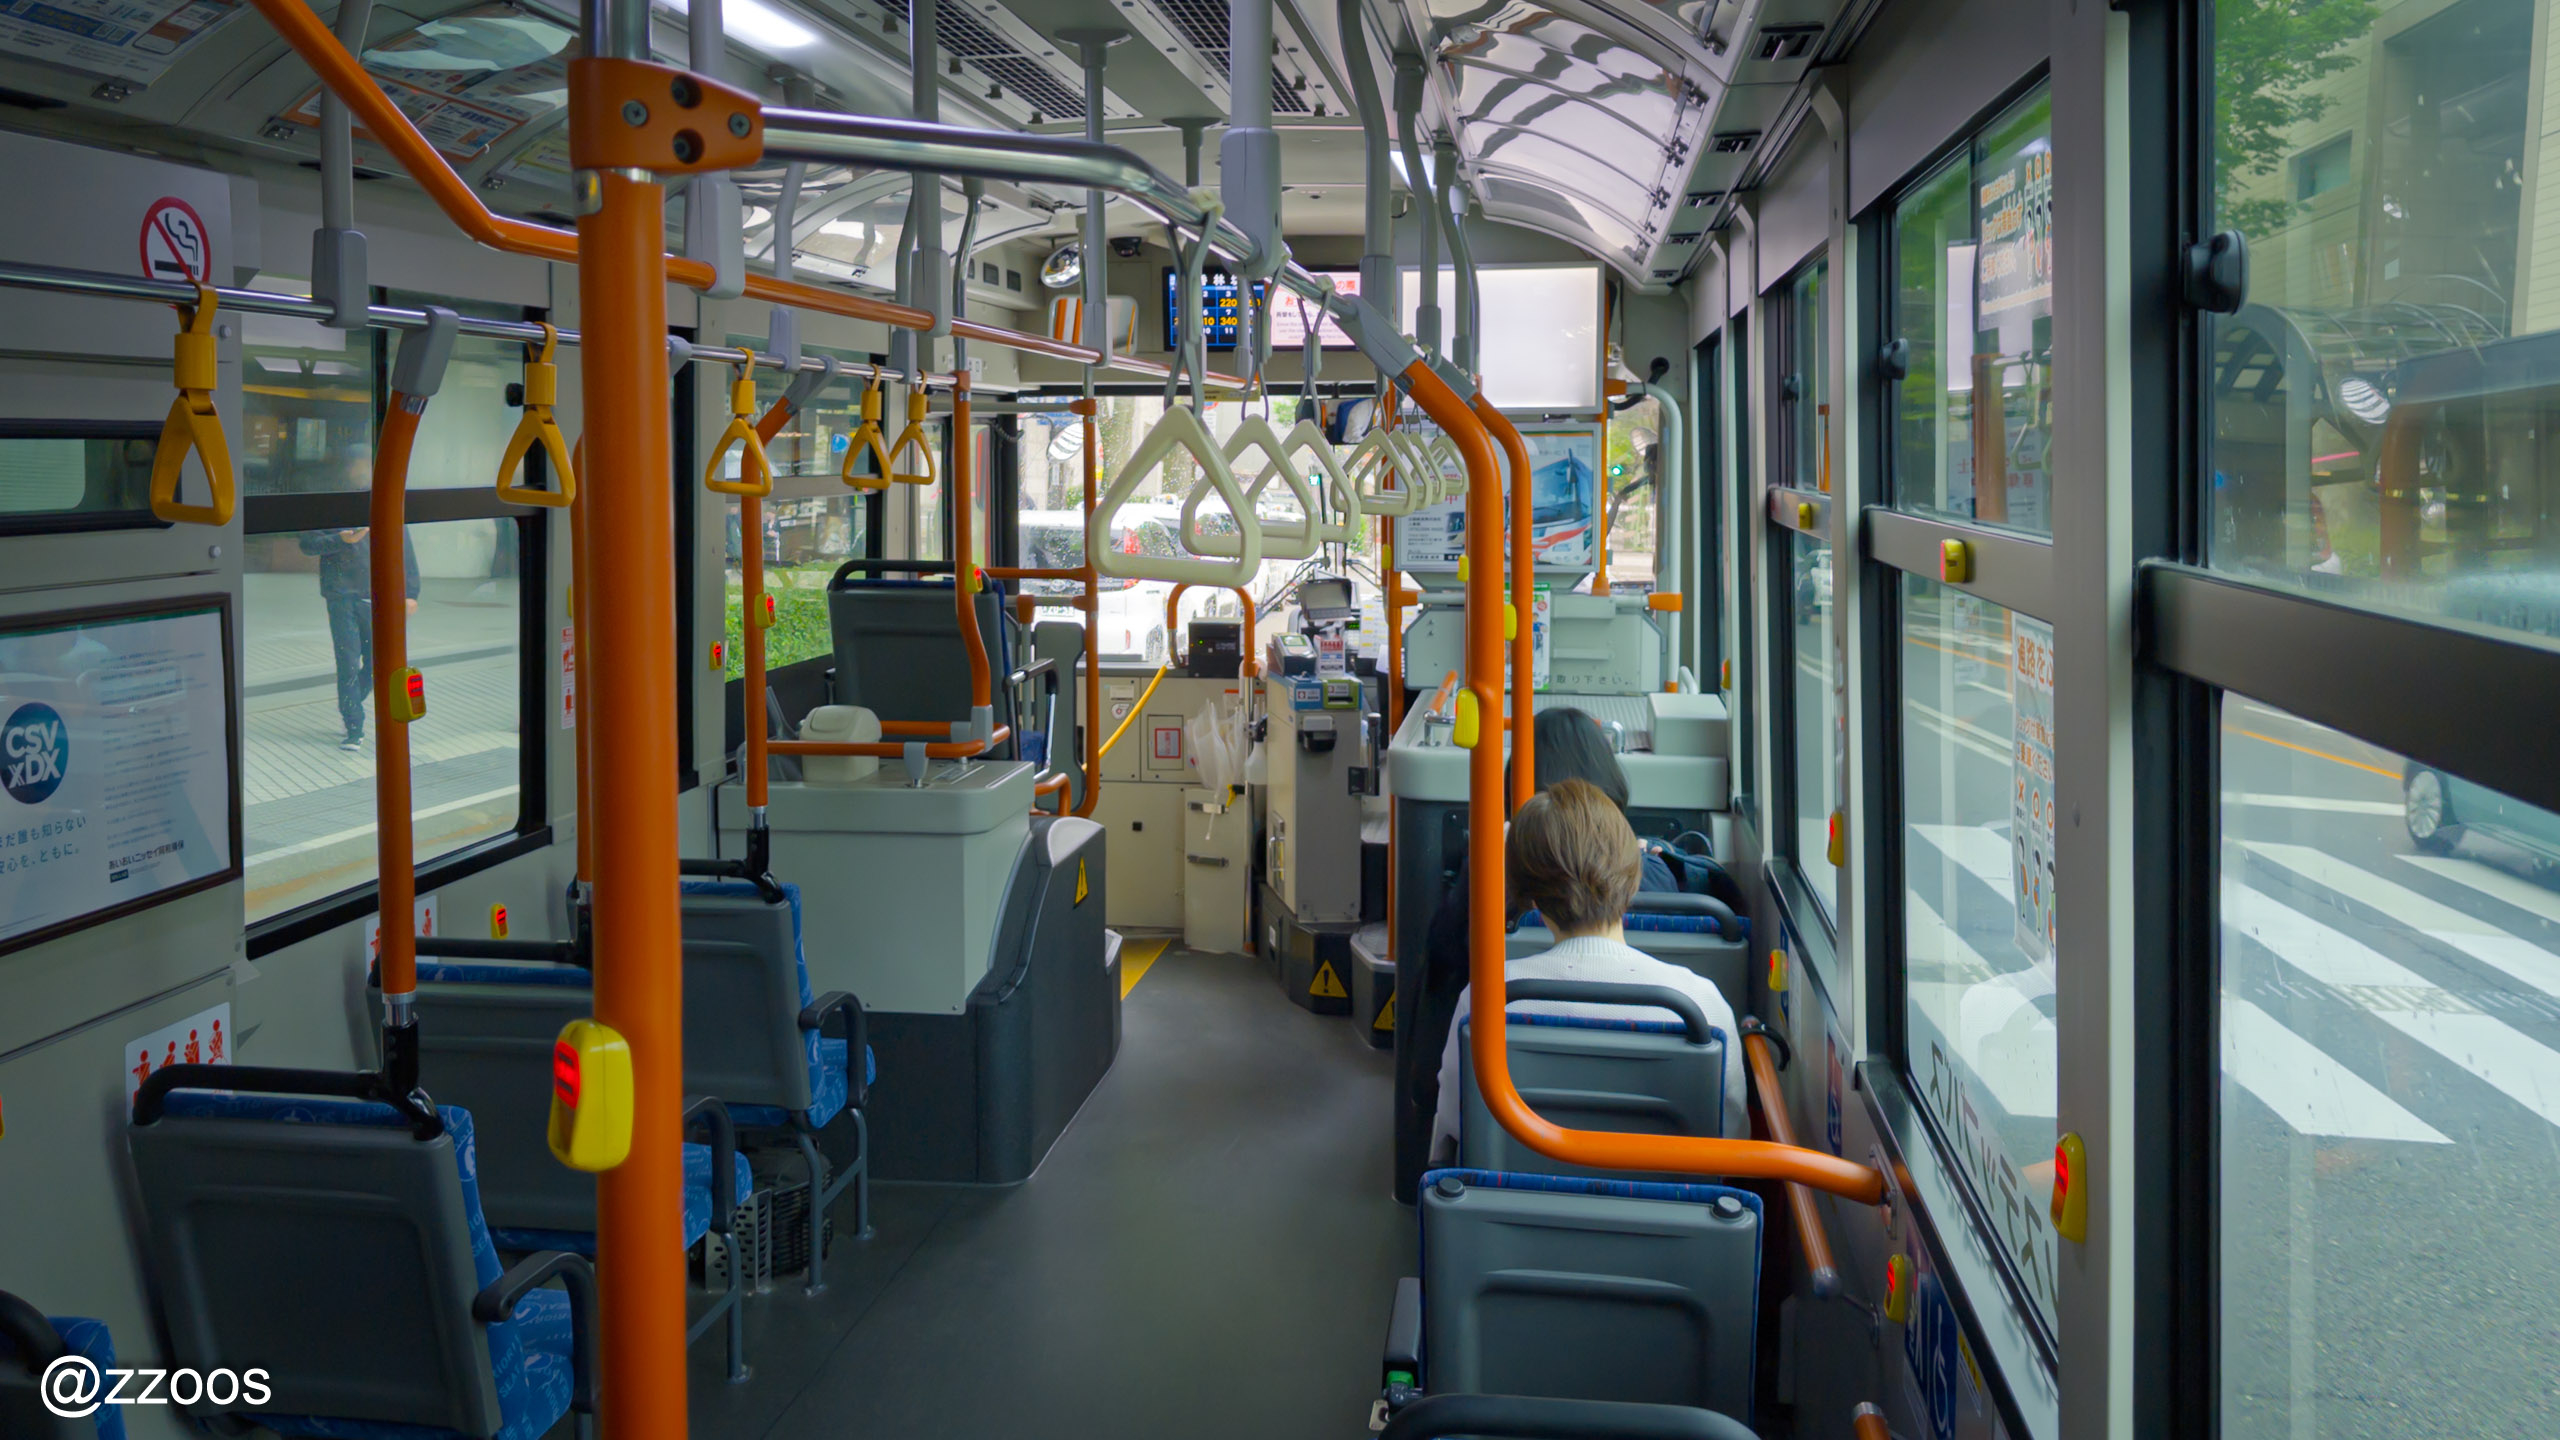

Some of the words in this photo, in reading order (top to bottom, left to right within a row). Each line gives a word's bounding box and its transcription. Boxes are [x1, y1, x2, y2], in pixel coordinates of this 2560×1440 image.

[1219, 298, 1238, 307] 220
[1219, 317, 1238, 326] 340
[1224, 327, 1234, 335] 11
[6, 720, 60, 759] CSV
